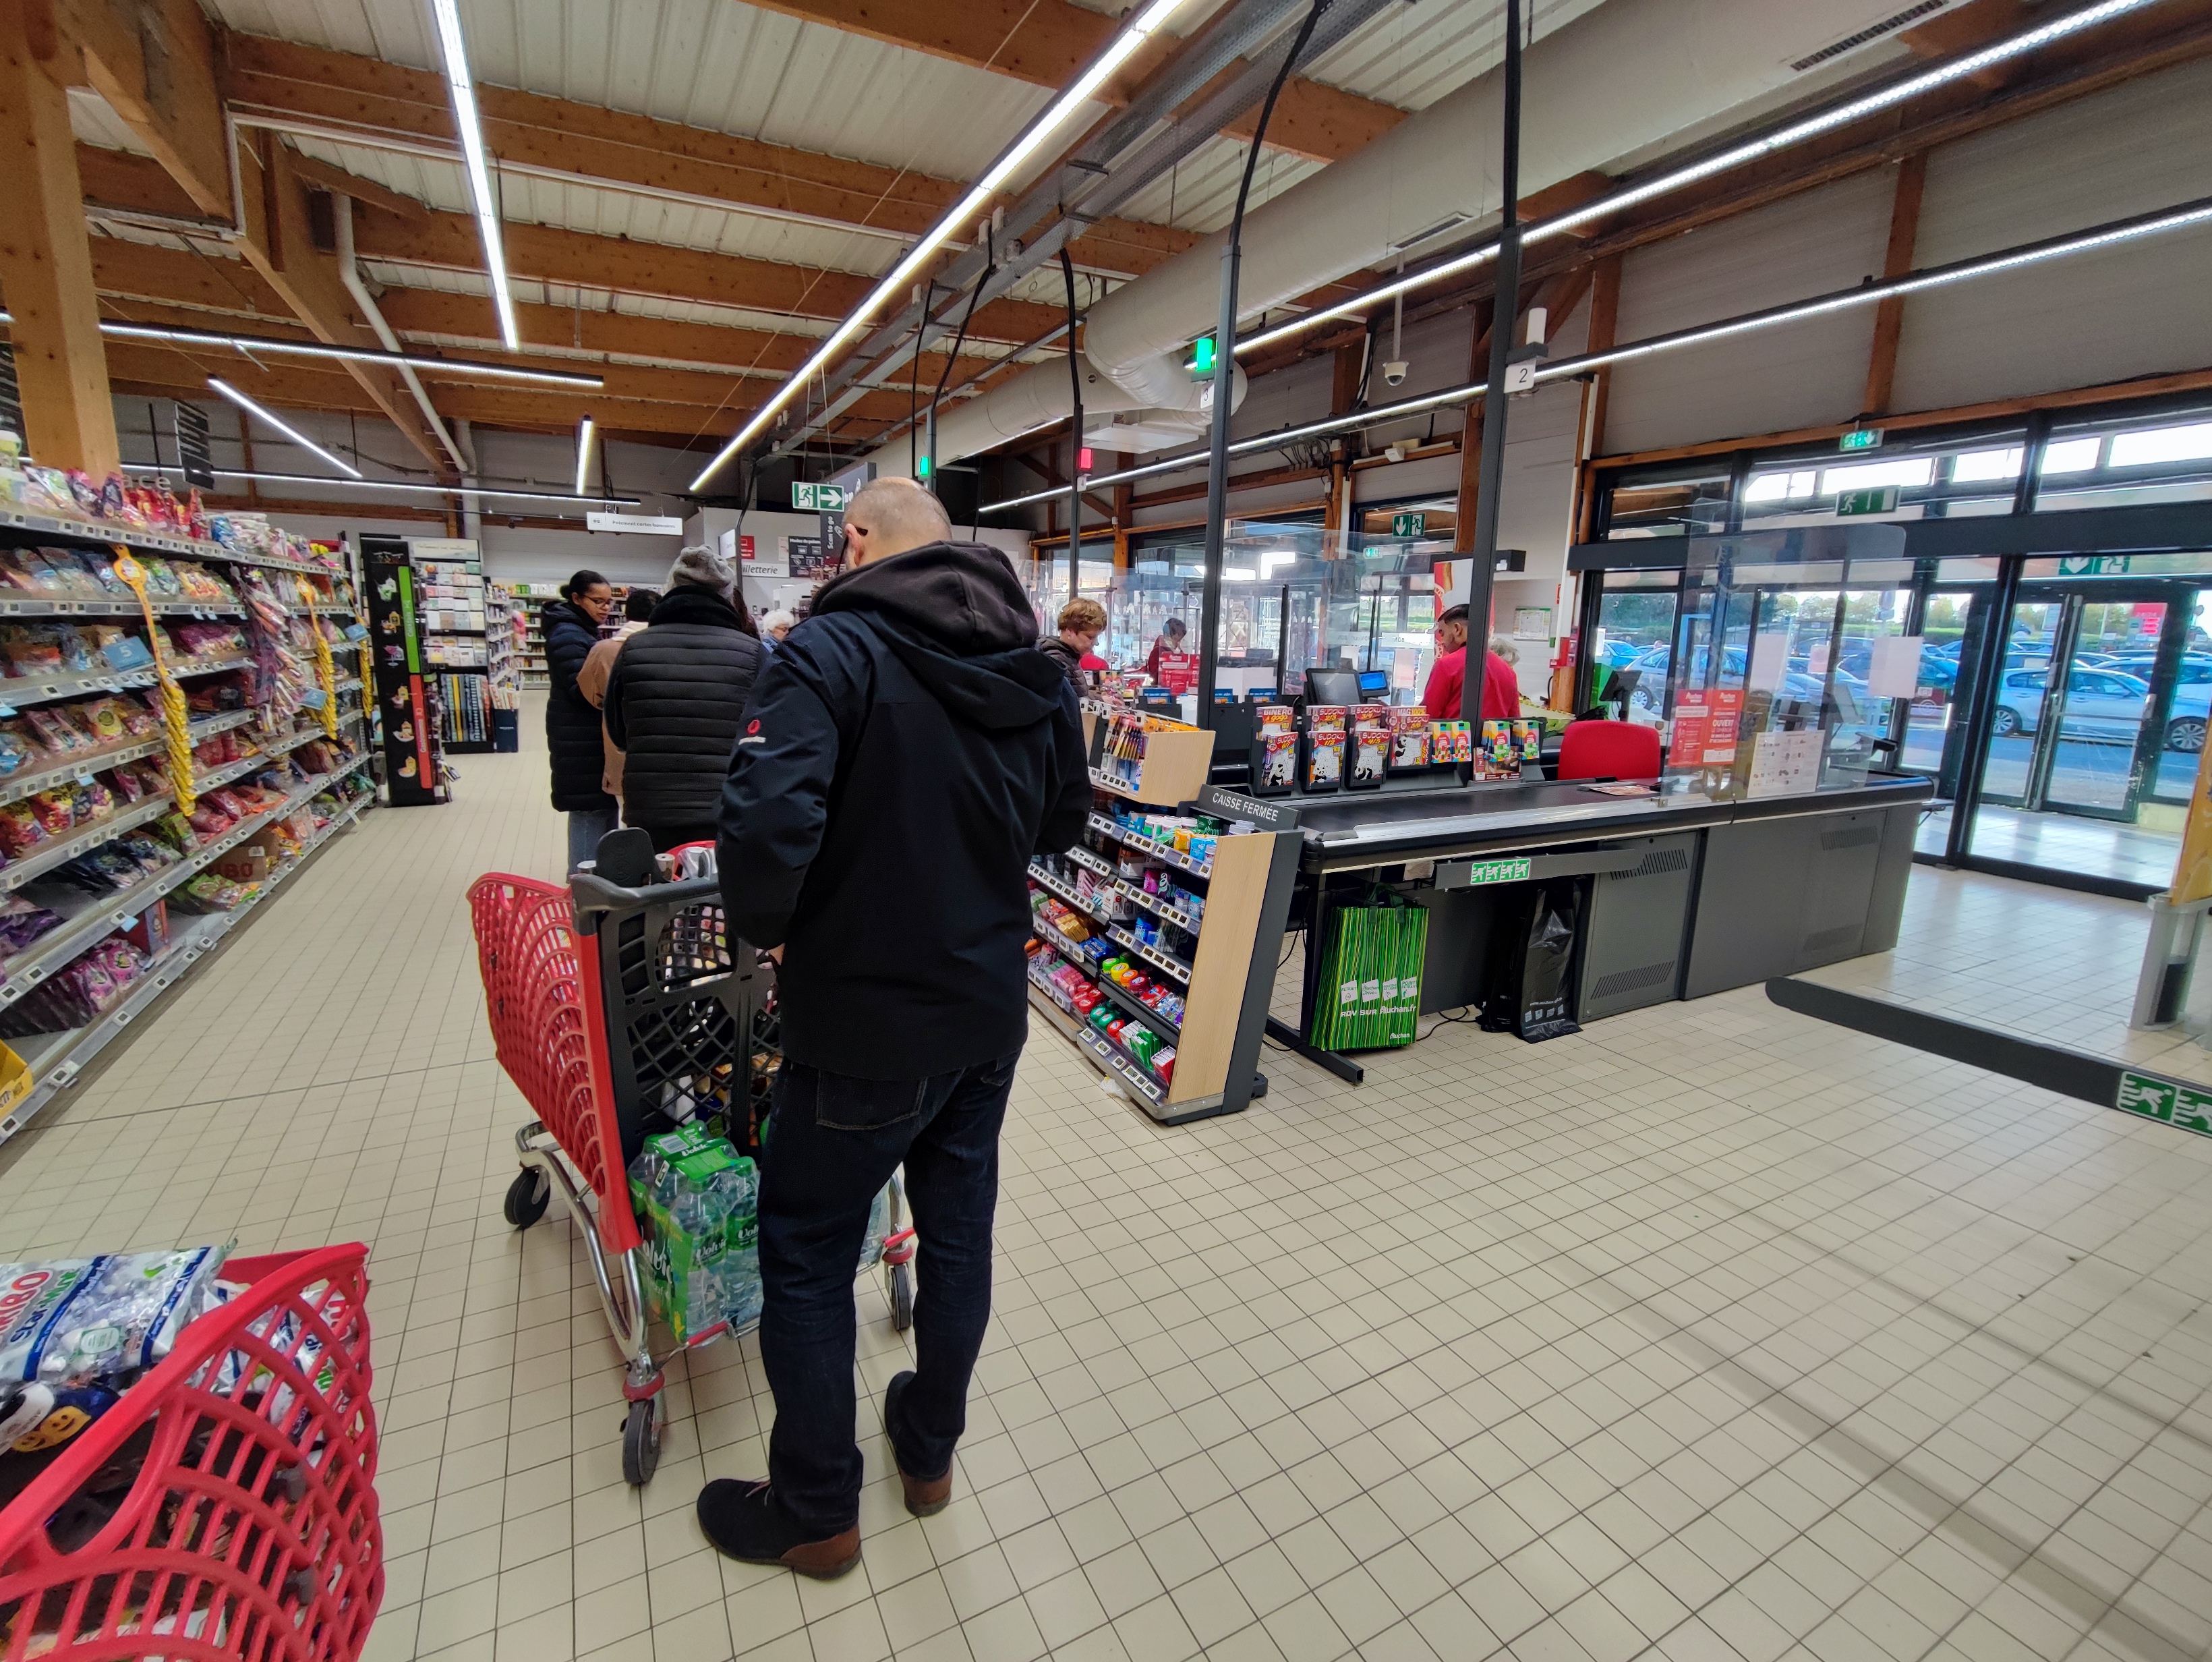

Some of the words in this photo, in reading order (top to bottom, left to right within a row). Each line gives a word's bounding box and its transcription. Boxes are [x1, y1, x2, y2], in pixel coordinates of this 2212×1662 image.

[1519, 368, 1528, 384] 2
[123, 474, 171, 491] ace
[743, 565, 778, 575] illetterie
[119, 645, 133, 658] 5
[1277, 735, 1298, 744] SUDOKU
[1213, 793, 1242, 810] CAISSE
[1242, 801, 1279, 822] FERMÉE
[1379, 1004, 1416, 1014] Auchan.fr
[681, 1143, 709, 1157] Volvic
[696, 1236, 728, 1260] Volvic
